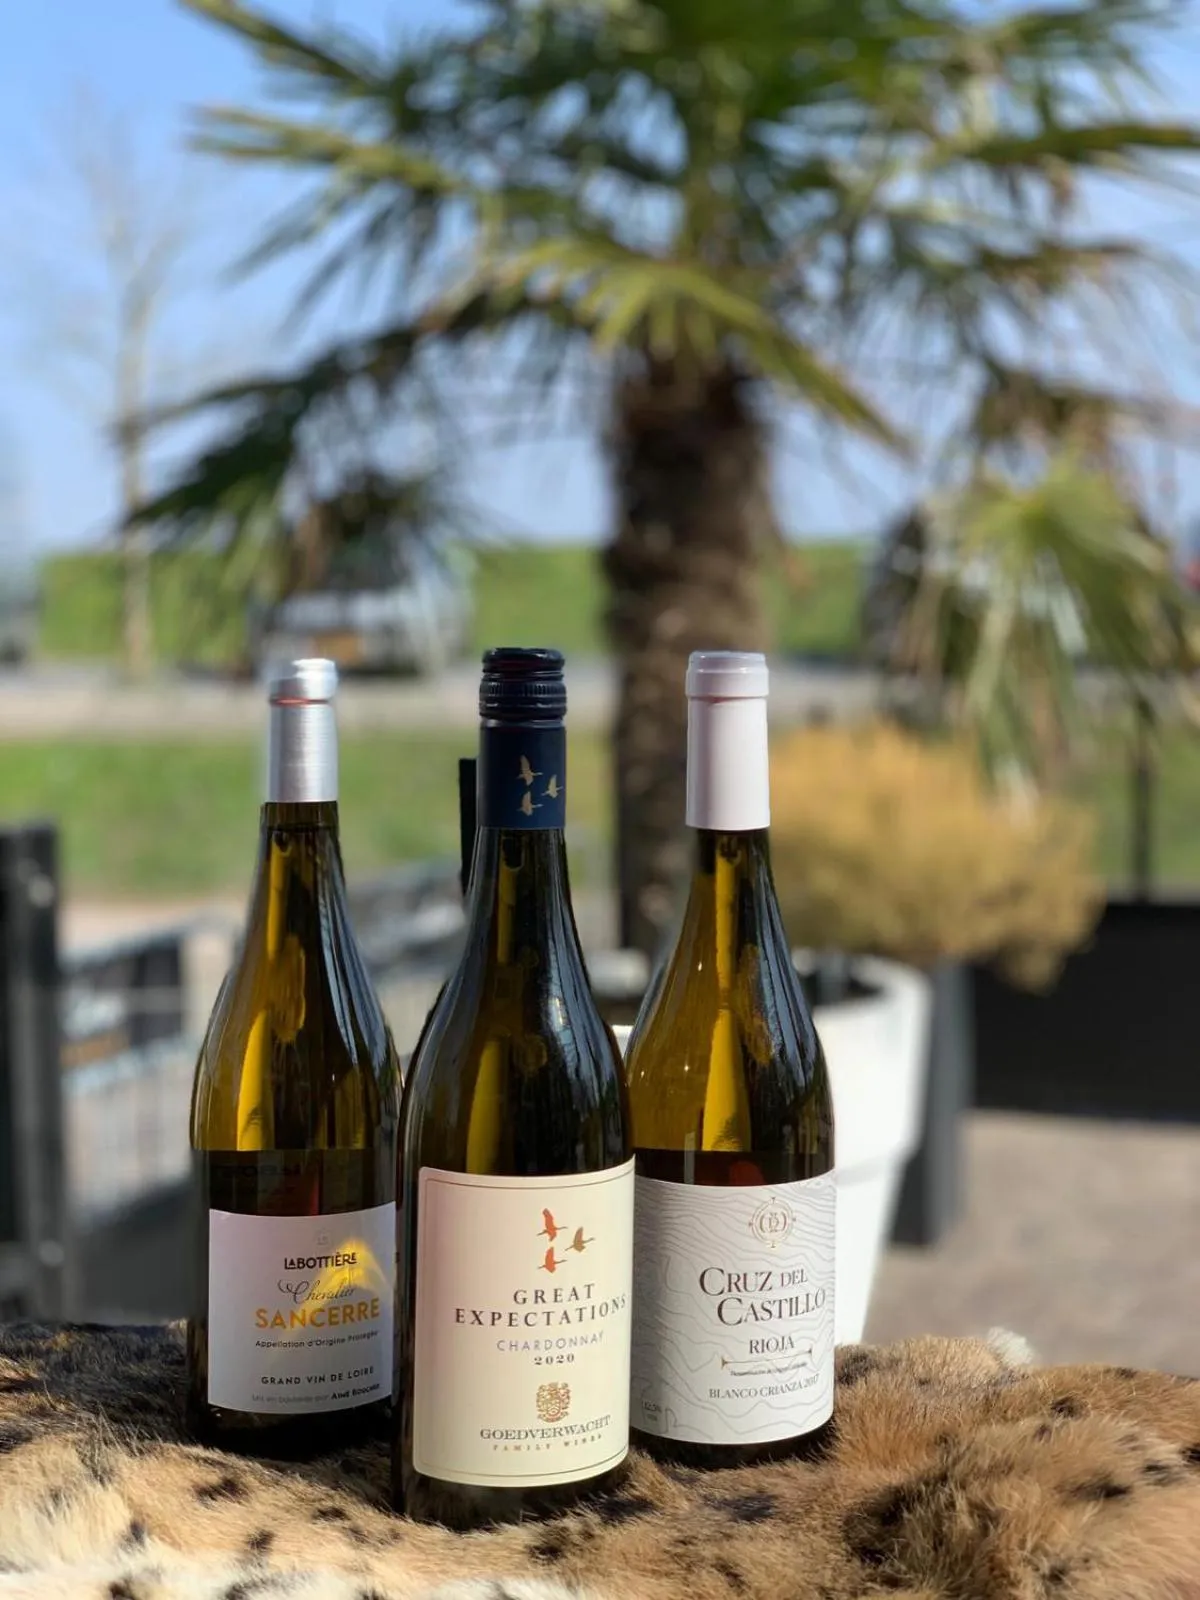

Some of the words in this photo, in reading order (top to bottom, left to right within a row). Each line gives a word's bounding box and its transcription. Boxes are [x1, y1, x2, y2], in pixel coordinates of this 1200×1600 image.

[699, 1266, 773, 1297] CRUZ
[780, 1269, 808, 1288] DEL
[513, 1283, 595, 1305] GREAT
[255, 1298, 380, 1329] SANCERRE
[455, 1293, 627, 1328] EXPECTATIONS
[717, 1287, 826, 1326] CASTILLO
[255, 1339, 305, 1349] Appellation
[496, 1331, 604, 1352] CHARDONNAY
[749, 1335, 795, 1354] RIOJA
[533, 1353, 575, 1366] 2020
[260, 1376, 302, 1385] GRAND
[306, 1374, 327, 1384] VIN
[330, 1372, 344, 1382] DE
[347, 1366, 375, 1380] LOIRE
[709, 1387, 758, 1399] BLANCO
[760, 1380, 804, 1398] CRIANZA
[479, 1414, 611, 1441] GOEDVERWACHT
[493, 1443, 551, 1452] FAMILY
